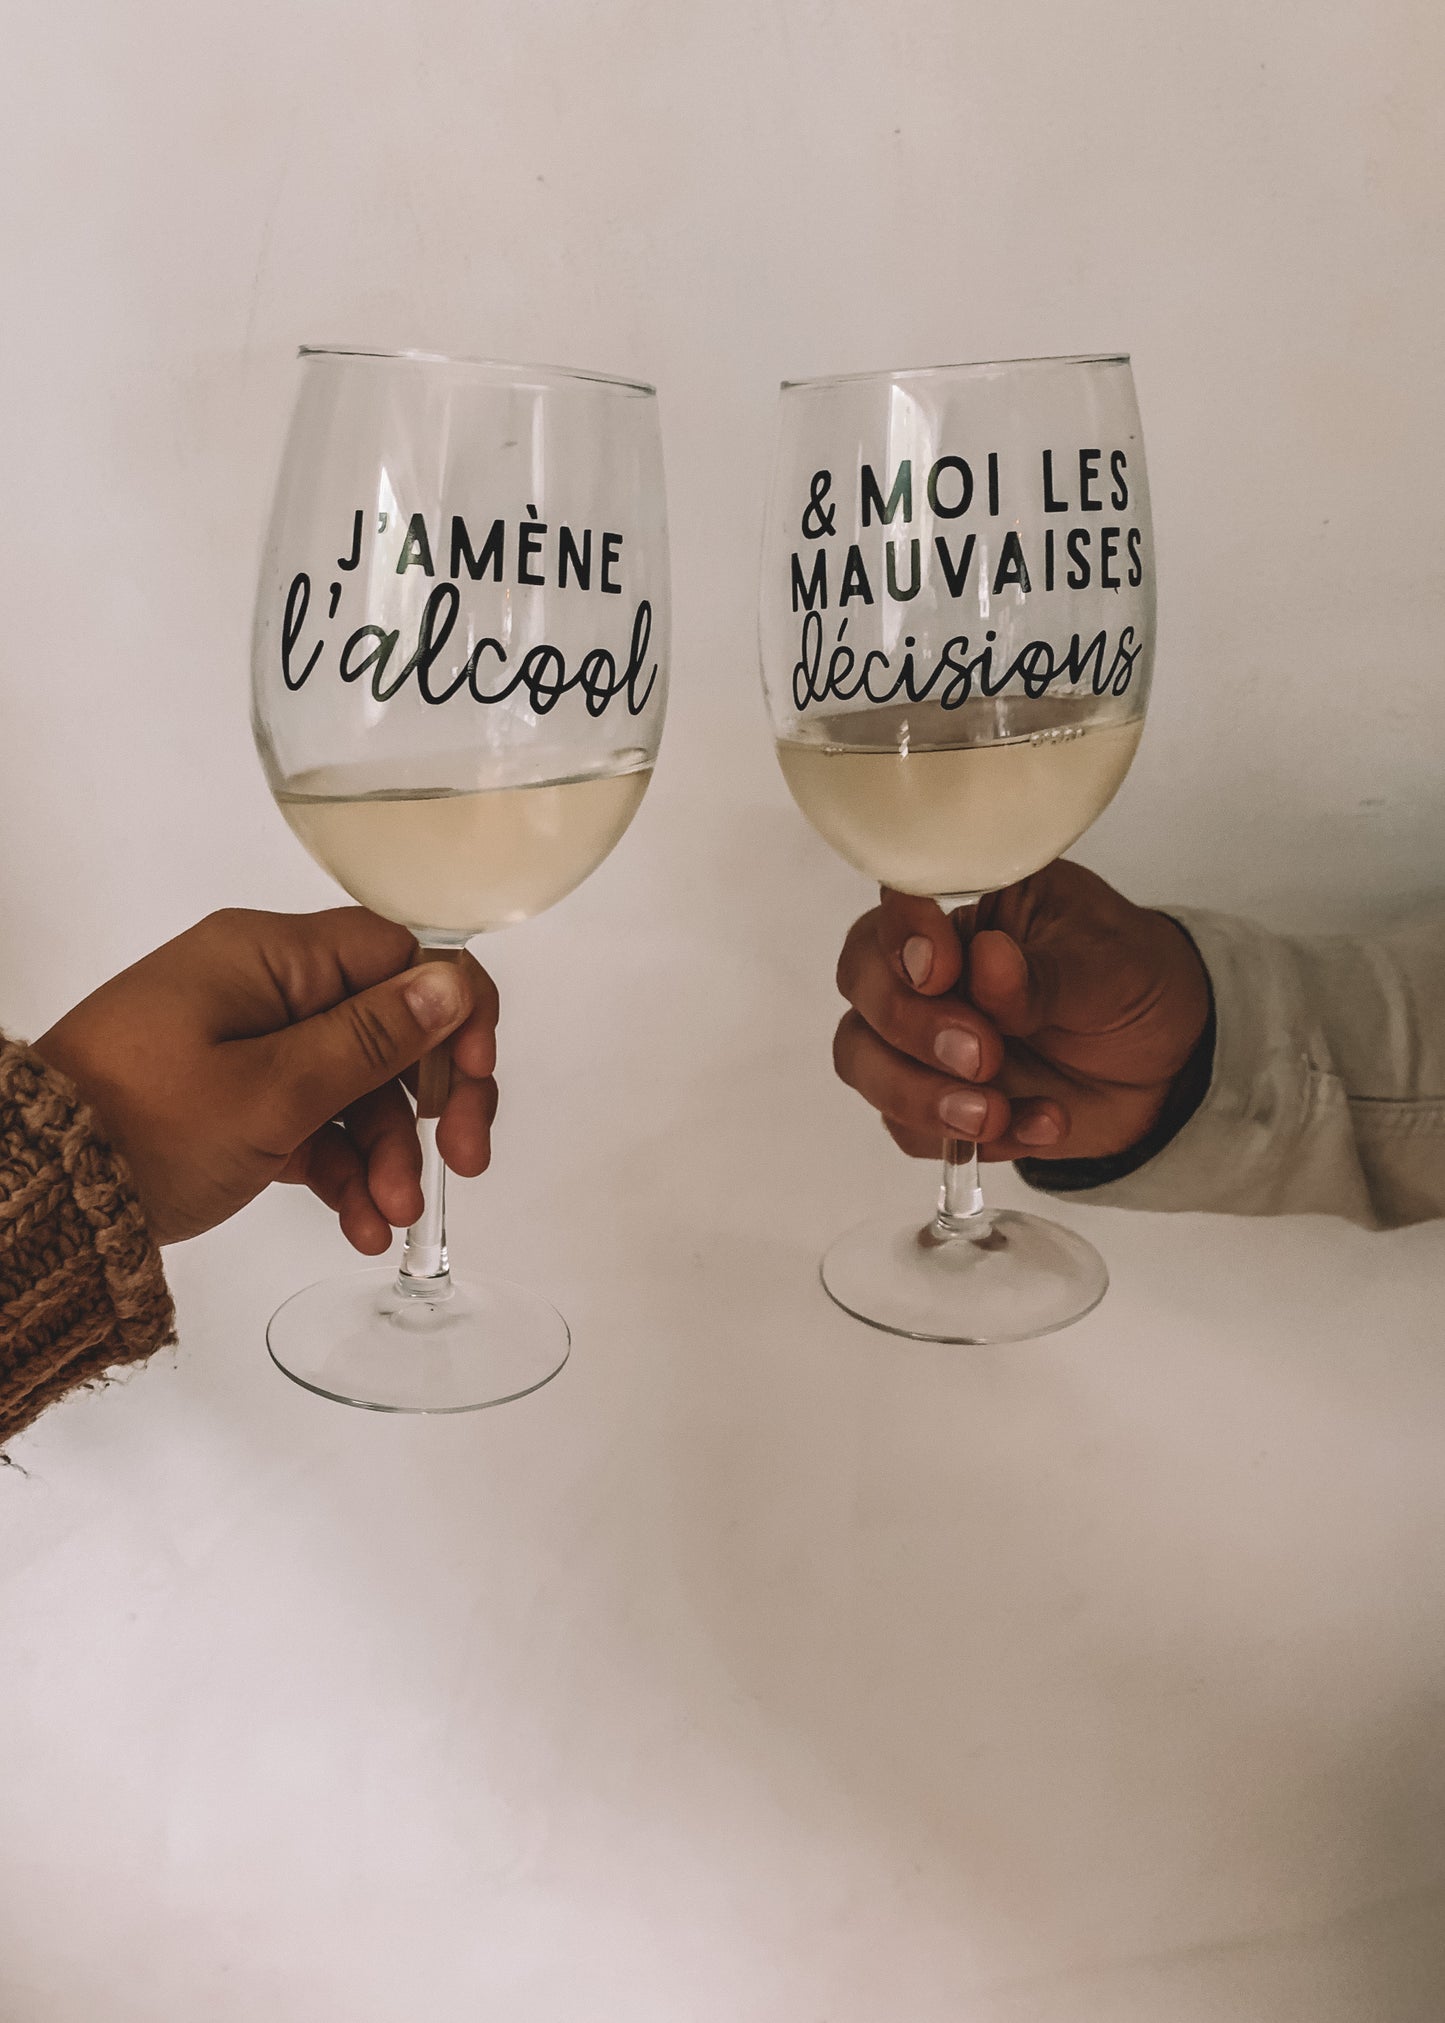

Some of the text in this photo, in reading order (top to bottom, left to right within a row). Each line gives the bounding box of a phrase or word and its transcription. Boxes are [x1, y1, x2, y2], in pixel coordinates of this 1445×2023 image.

[801, 448, 1129, 540] & MOI LES
[337, 504, 623, 594] J'AMÈNE
[791, 527, 1142, 613] MAUVAISES
[281, 572, 658, 718] l'alcool
[792, 610, 1143, 712] décisions
